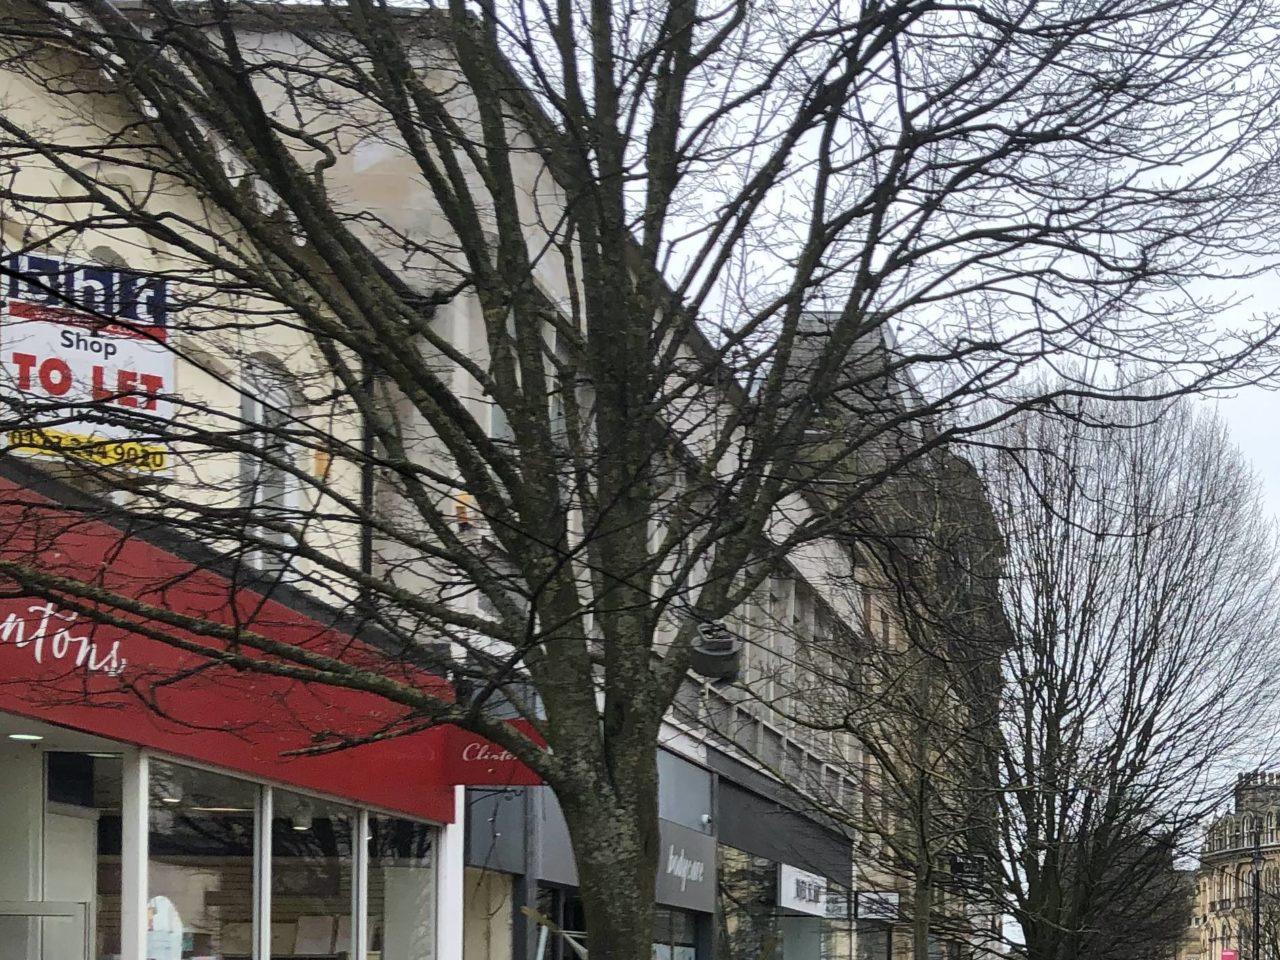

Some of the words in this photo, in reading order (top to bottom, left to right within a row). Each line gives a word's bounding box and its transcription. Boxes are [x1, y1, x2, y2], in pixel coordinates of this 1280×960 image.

[60, 329, 117, 360] Shop
[12, 352, 72, 396] TO
[92, 365, 163, 411] LET
[462, 742, 518, 762] Clinto
